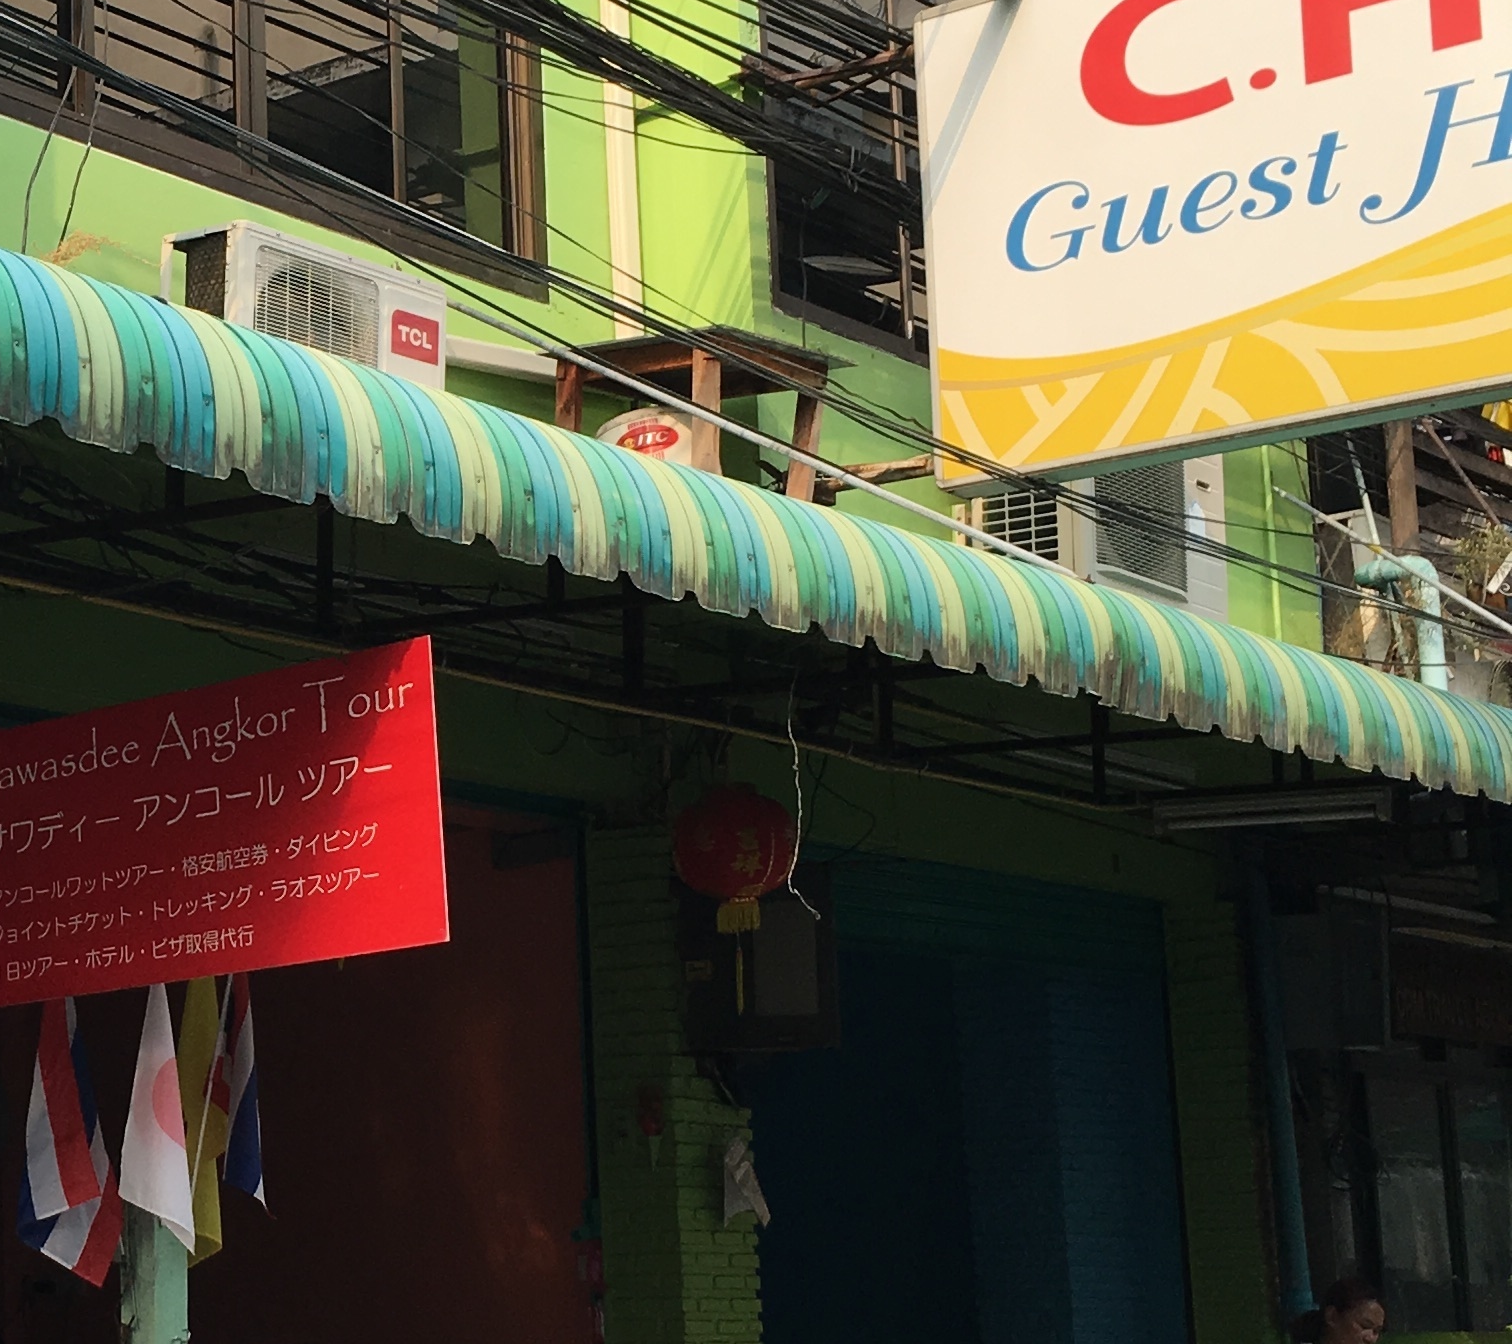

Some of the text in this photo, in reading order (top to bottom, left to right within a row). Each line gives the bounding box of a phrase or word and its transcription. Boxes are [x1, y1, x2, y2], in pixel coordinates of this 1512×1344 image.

[1004, 130, 1349, 274] Guest
[397, 323, 433, 350] TCL
[638, 430, 668, 446] ITC
[151, 696, 296, 766] Angkor
[302, 674, 414, 734] Tour
[133, 775, 285, 831] アンコール
[297, 756, 394, 803] ツアー
